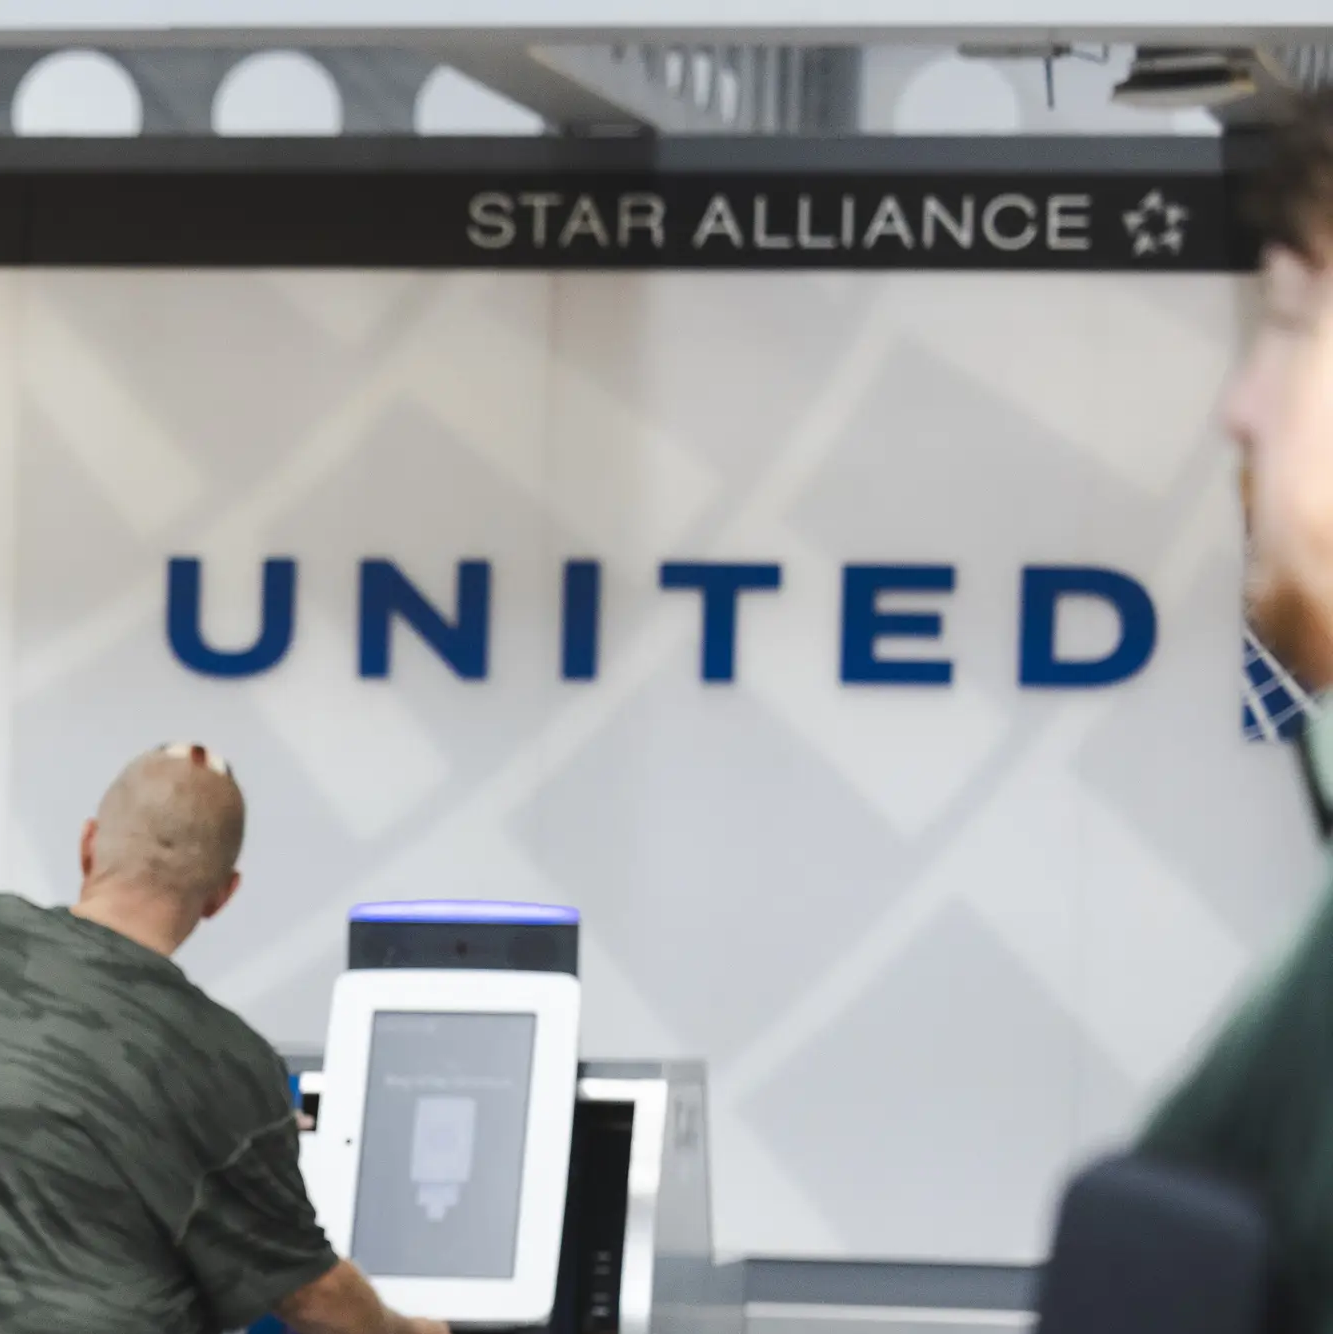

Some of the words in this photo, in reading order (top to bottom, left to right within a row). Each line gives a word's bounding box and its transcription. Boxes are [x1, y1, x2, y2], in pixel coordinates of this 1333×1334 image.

[466, 191, 667, 250] STAR
[692, 192, 1093, 252] ALLIANCE
[164, 555, 1160, 690] UNITED
